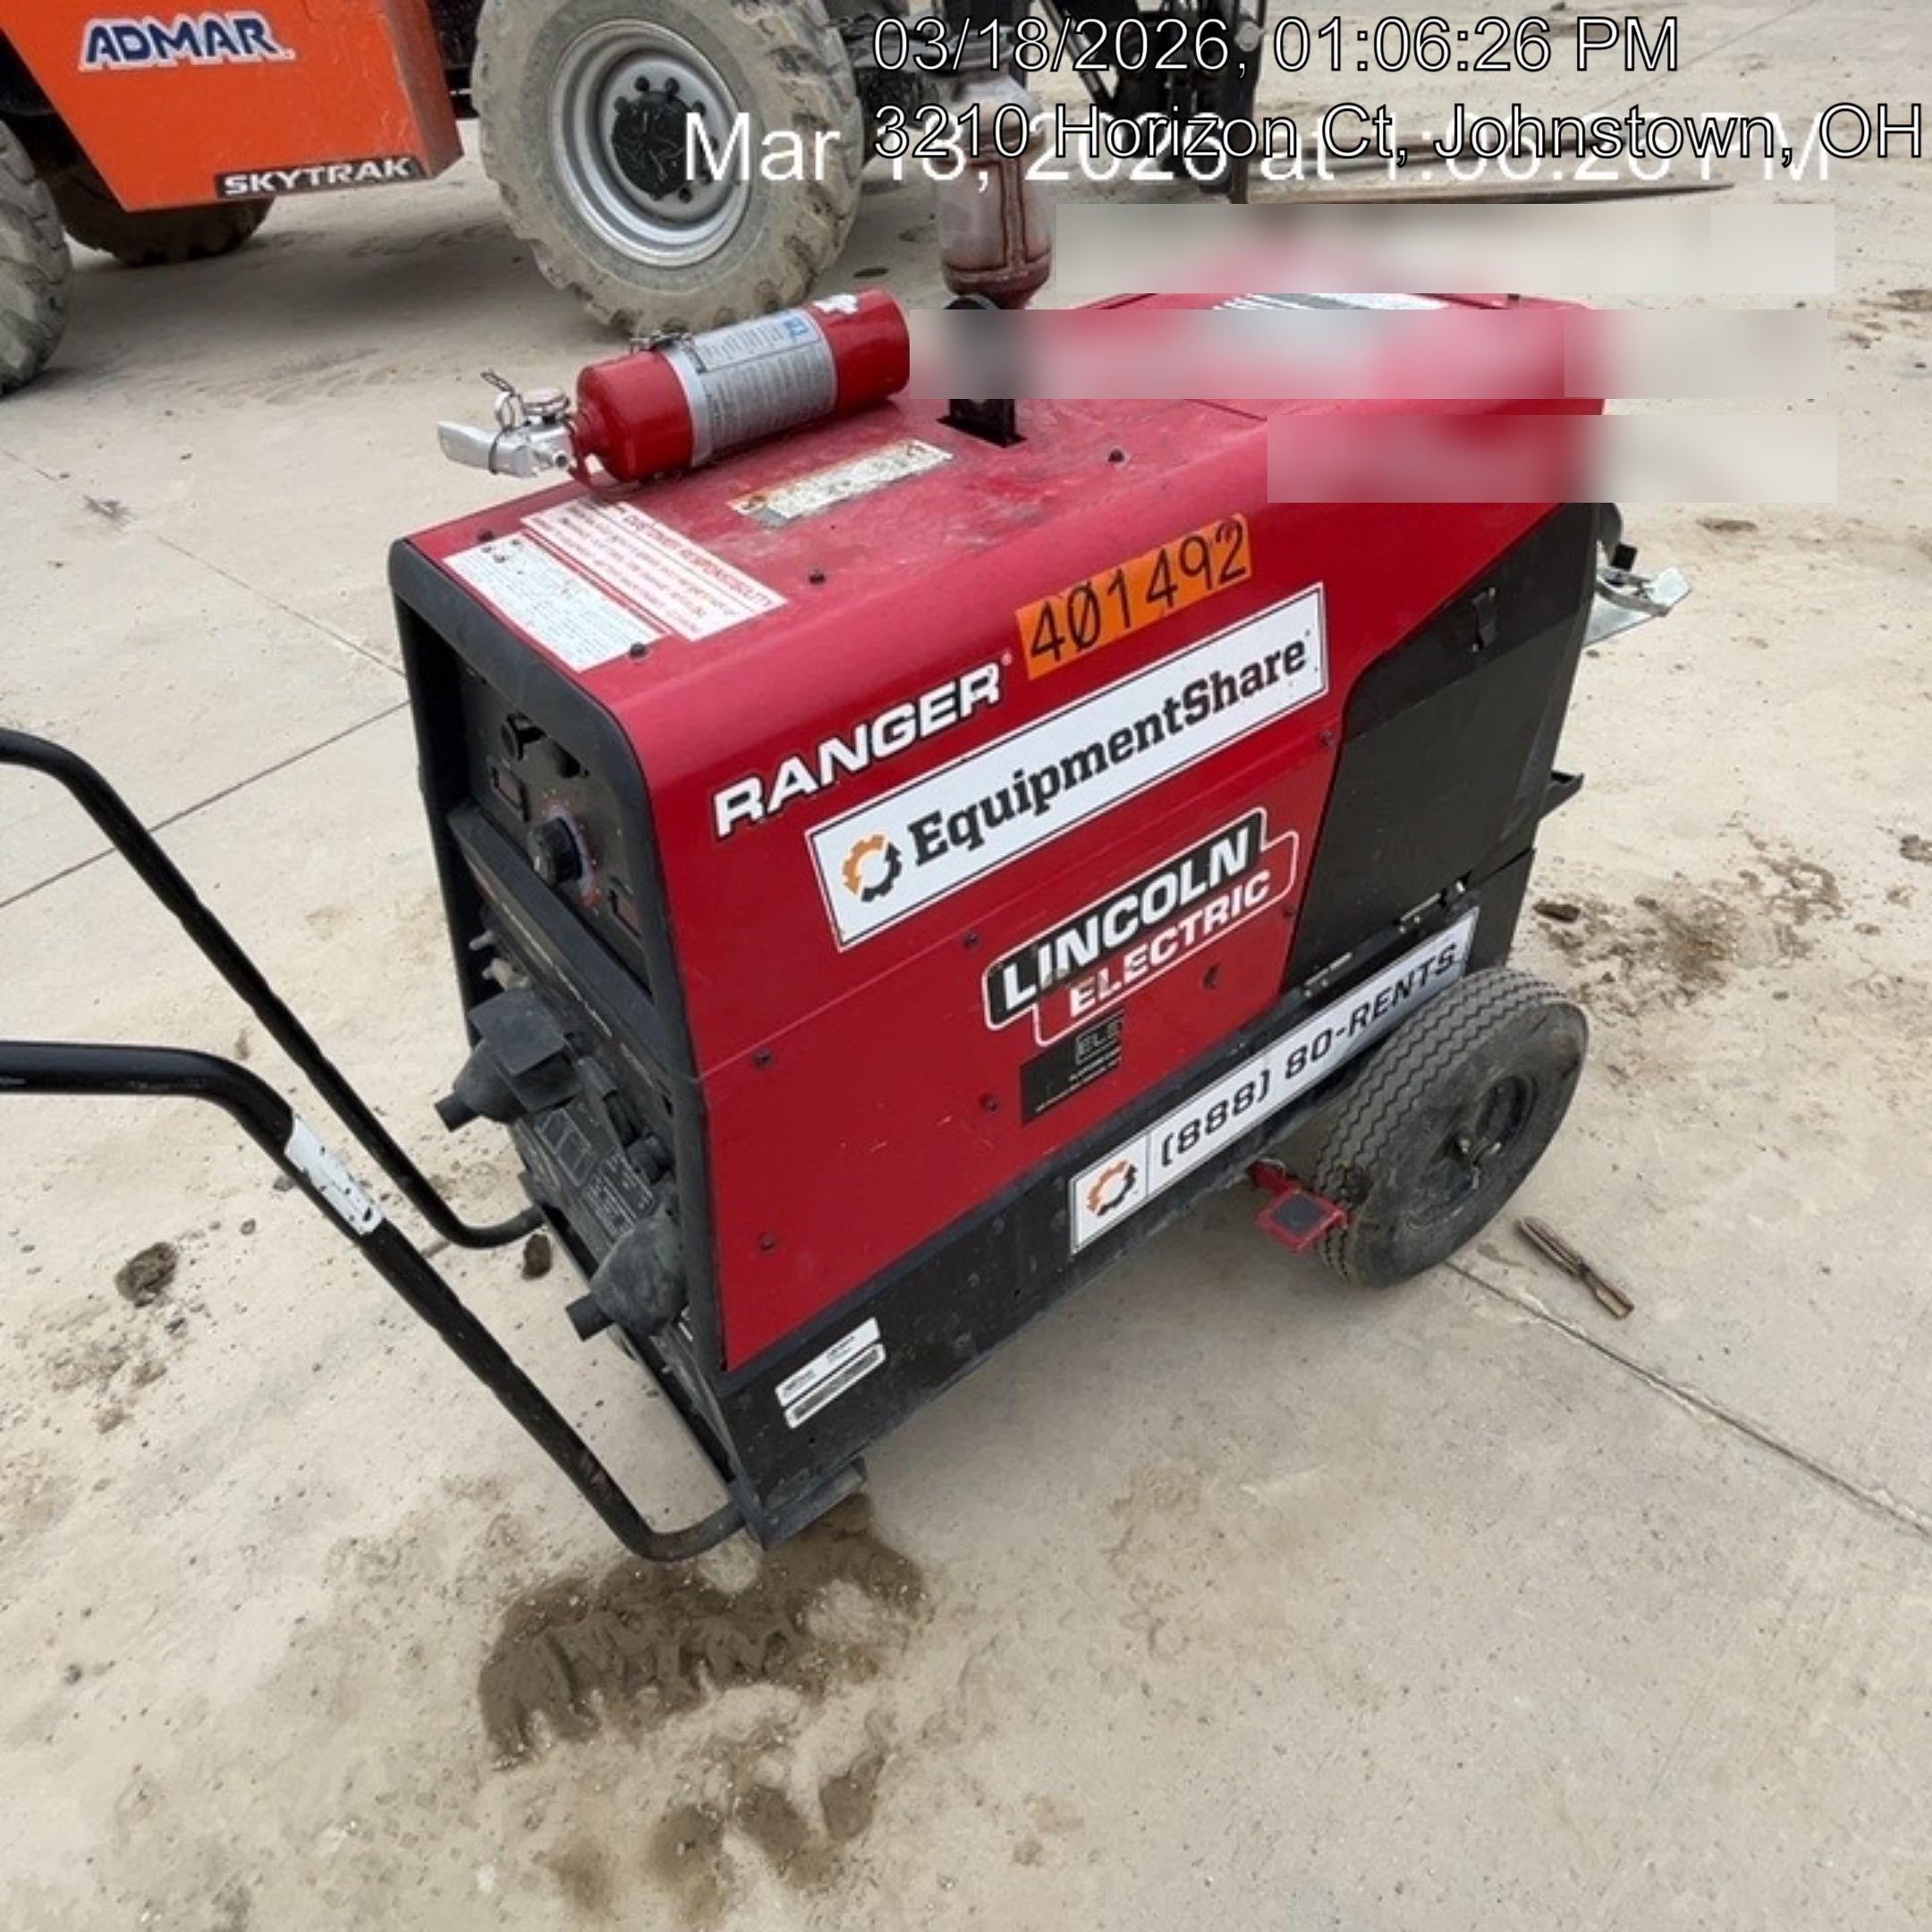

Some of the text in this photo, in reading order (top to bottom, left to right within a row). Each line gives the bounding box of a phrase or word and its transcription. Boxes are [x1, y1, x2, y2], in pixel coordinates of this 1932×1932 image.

[82, 14, 281, 66] ADMAR
[225, 157, 412, 196] SKYTRAK
[1030, 516, 1247, 663] 401492
[714, 663, 1002, 840] RANGER
[907, 638, 1307, 867] EquipmentShare
[1003, 826, 1250, 1012] LINCOLN
[1070, 869, 1271, 1018] ELECTRIC
[1162, 1070, 1271, 1168] (888)
[1284, 942, 1458, 1081] 80-RENTS
